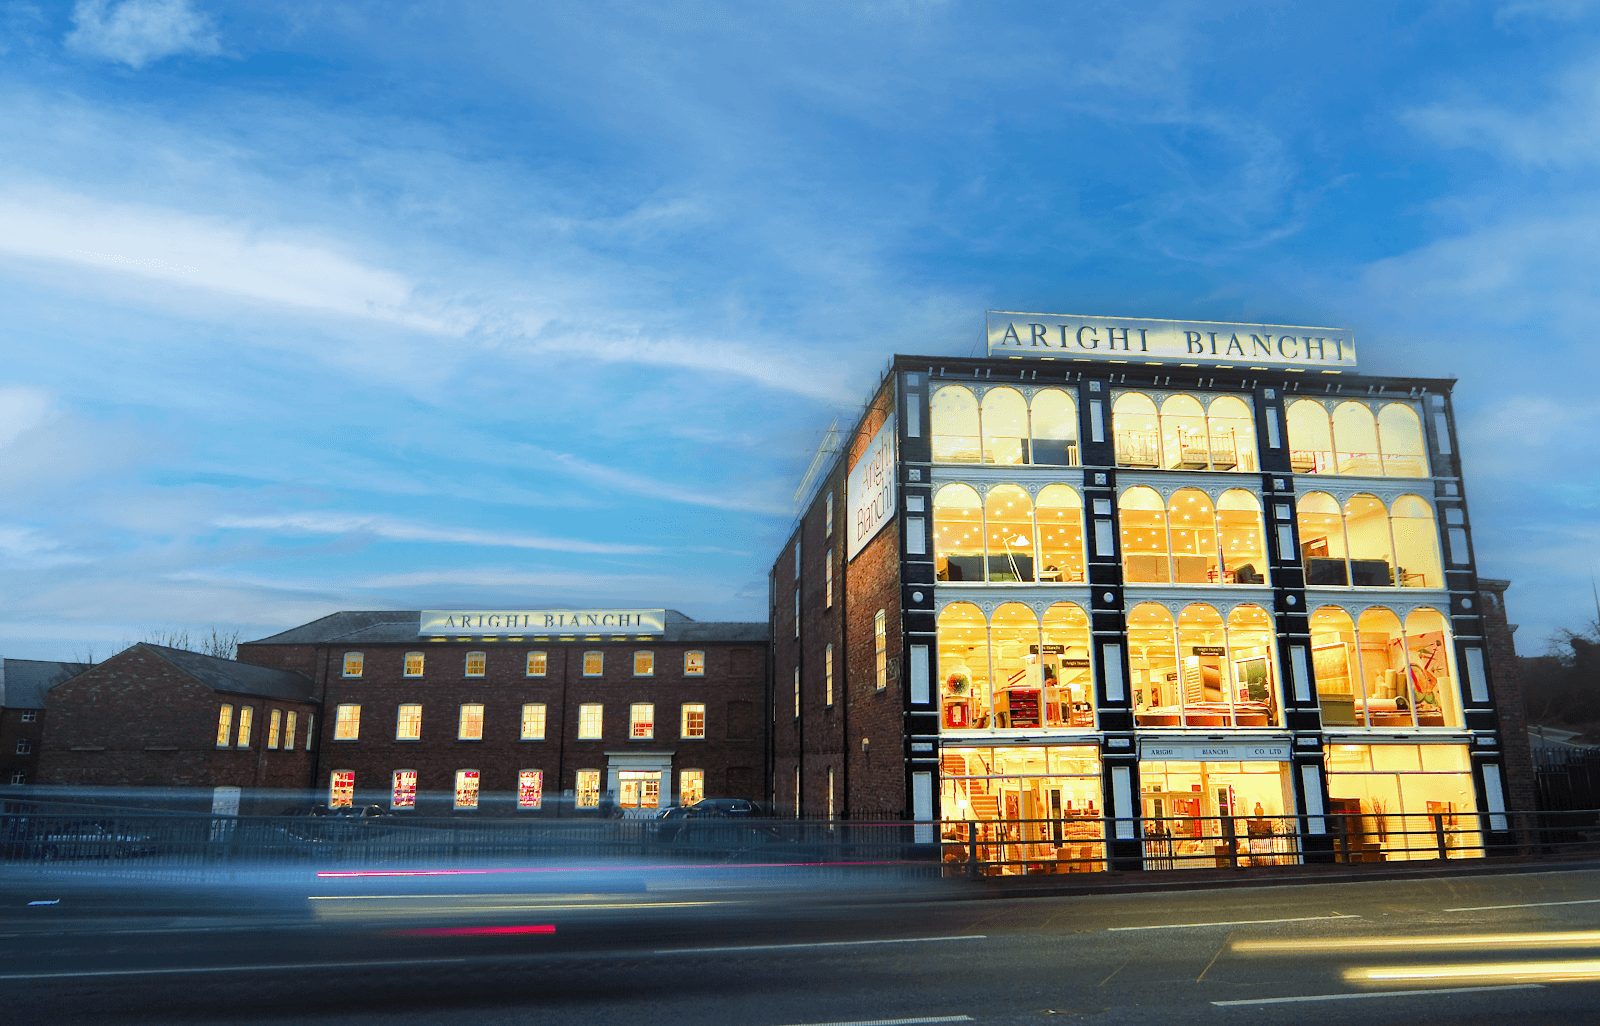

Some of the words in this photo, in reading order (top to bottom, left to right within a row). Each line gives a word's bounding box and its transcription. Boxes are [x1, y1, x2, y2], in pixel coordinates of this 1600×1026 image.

[1001, 322, 1150, 352] ARIGHI
[1183, 330, 1346, 361] BIANCHI
[862, 427, 891, 498] Arighi
[857, 471, 892, 542] Bianchi
[444, 614, 530, 628] ARIGHI
[543, 614, 642, 628] BIANCHI
